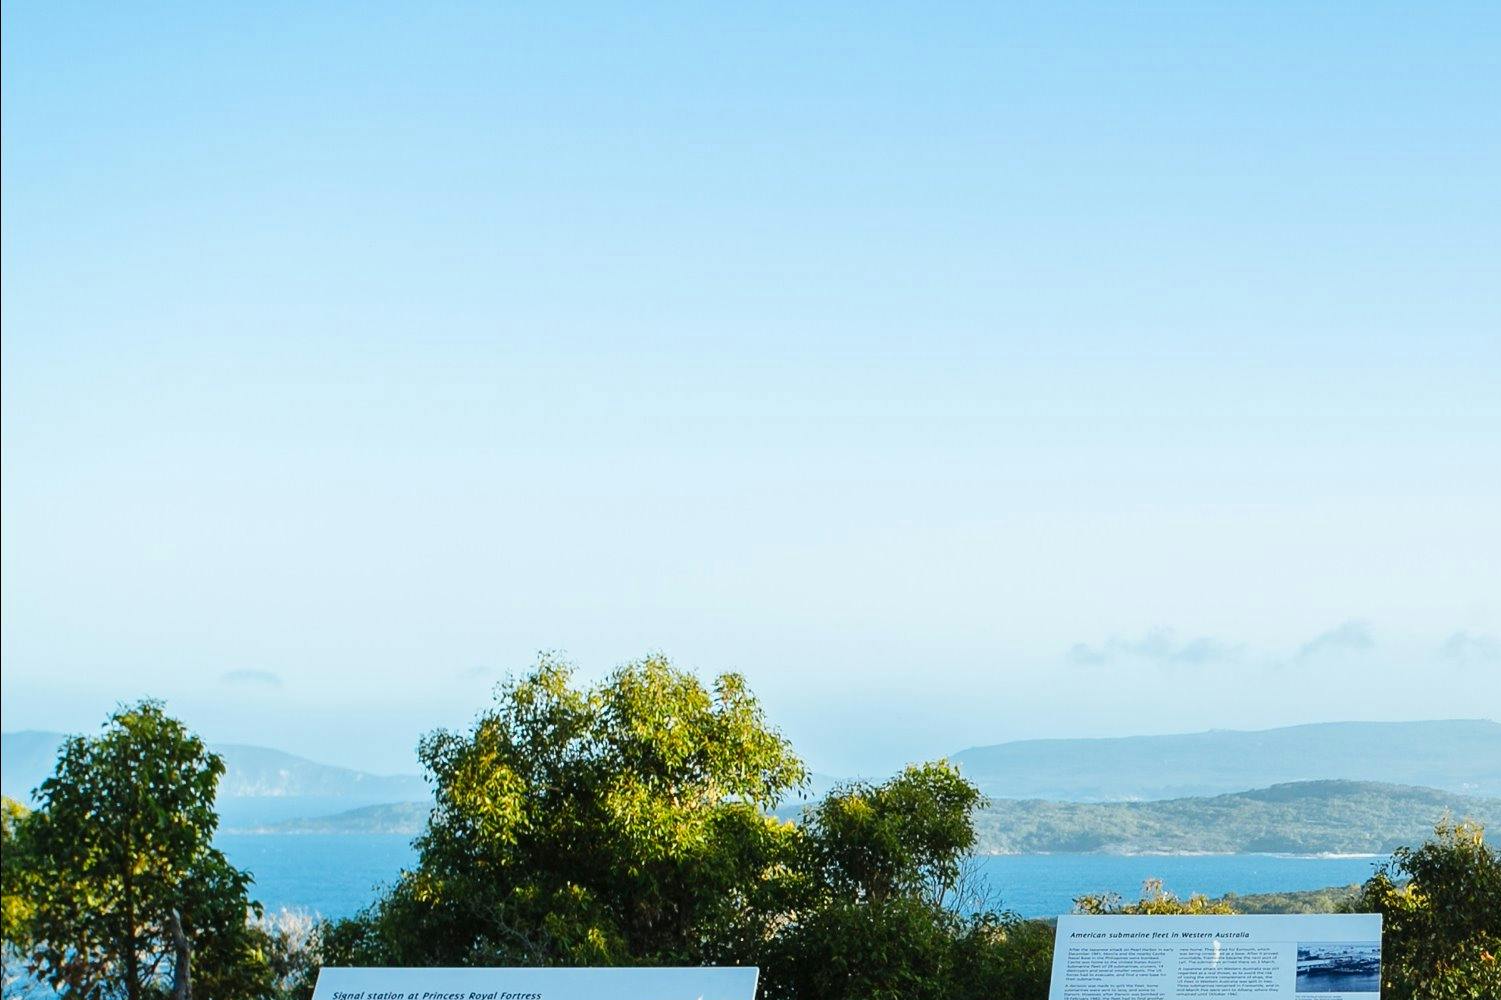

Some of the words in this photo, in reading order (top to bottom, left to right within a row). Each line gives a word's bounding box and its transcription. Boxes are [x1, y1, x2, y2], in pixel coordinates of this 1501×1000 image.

[333, 992, 365, 1000] Signal
[367, 992, 404, 1000] station
[423, 992, 465, 1000] Princess
[469, 992, 498, 1000] Royal
[501, 992, 542, 1000] Fortress
